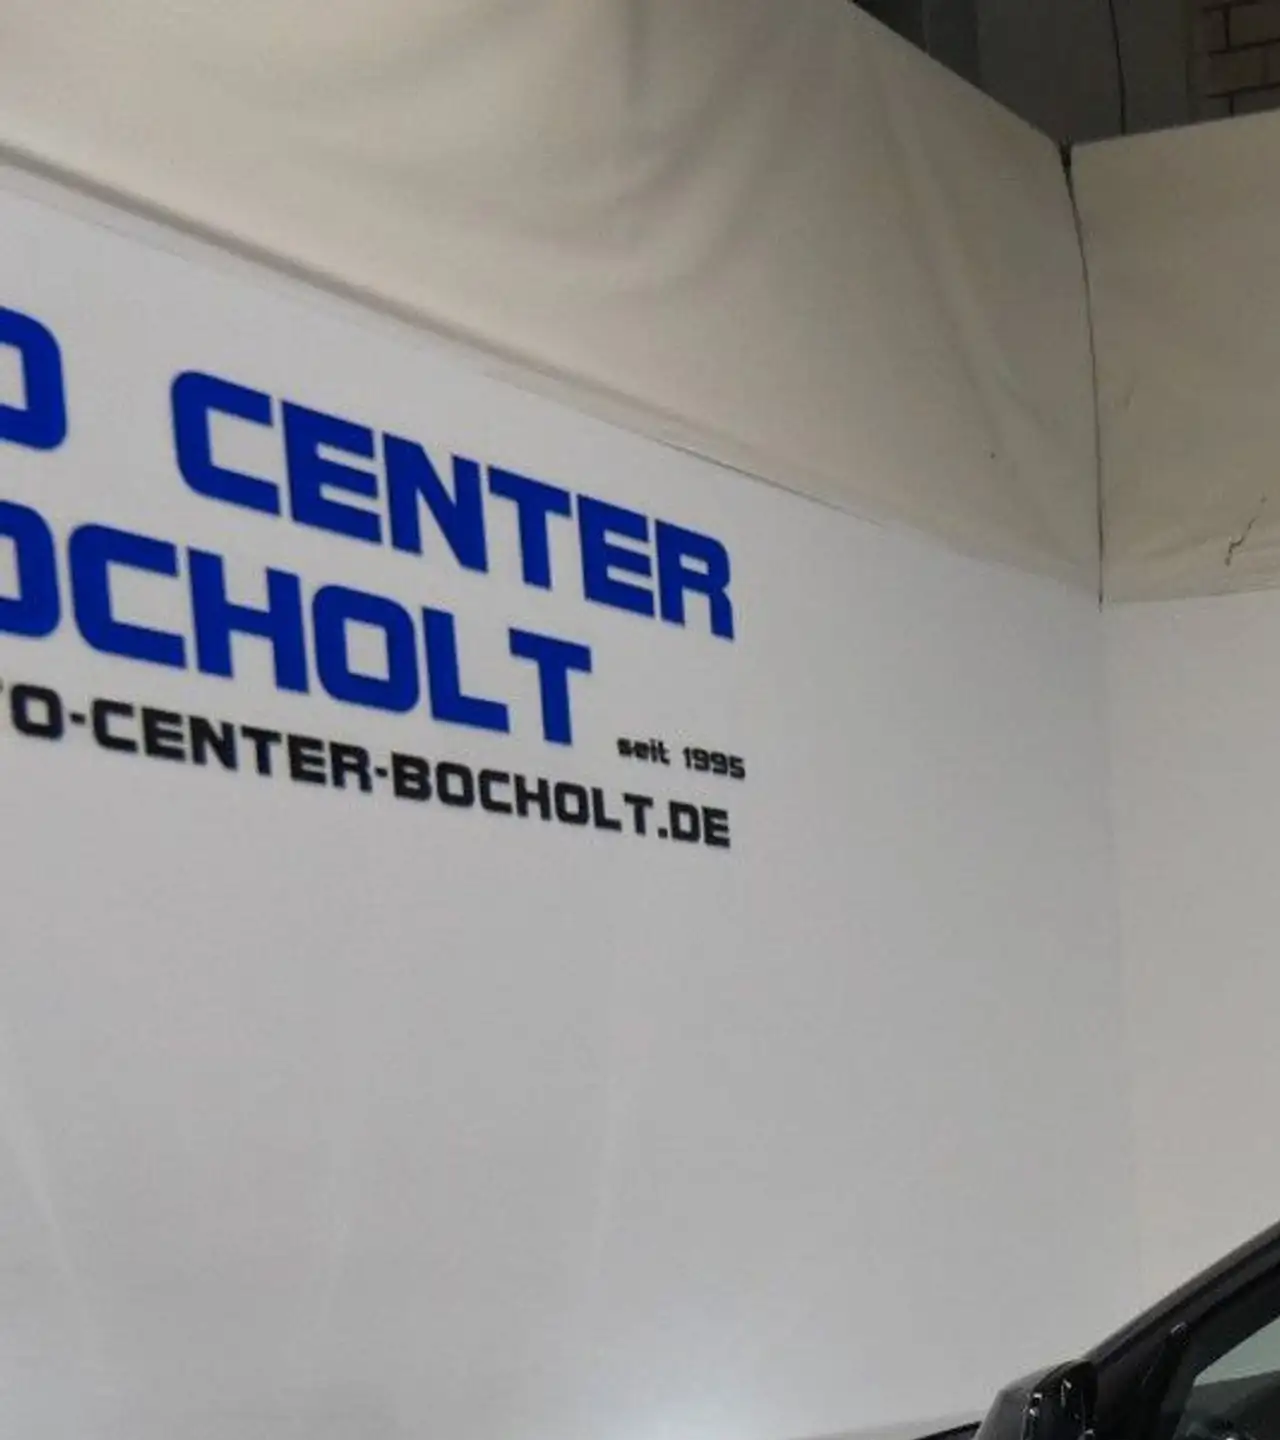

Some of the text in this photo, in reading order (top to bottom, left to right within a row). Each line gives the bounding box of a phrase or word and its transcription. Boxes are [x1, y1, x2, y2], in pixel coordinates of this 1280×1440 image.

[170, 370, 735, 640] CENTER
[0, 676, 731, 849] O-CENTER-BOCHOLT.DE
[616, 737, 746, 781] seit 1995
